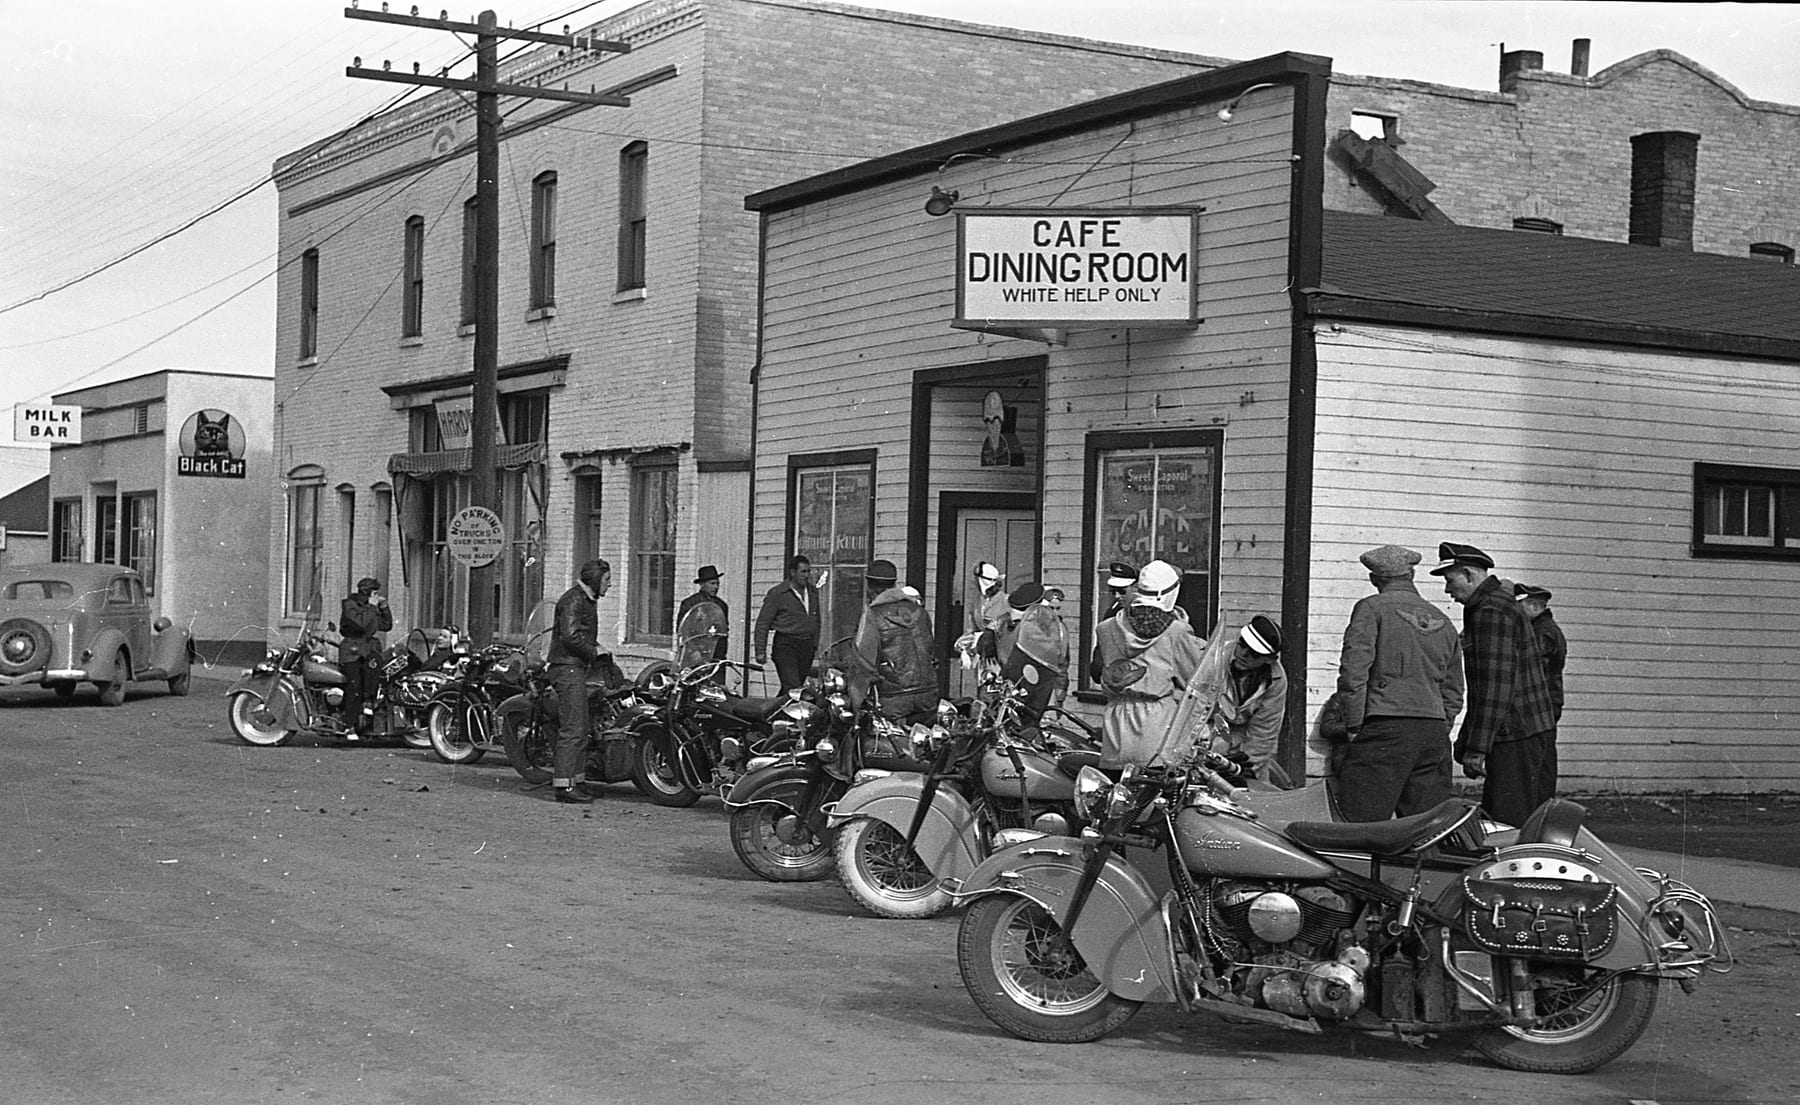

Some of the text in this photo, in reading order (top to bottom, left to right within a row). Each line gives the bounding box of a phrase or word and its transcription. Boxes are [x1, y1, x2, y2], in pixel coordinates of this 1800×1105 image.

[1033, 220, 1121, 247] CAFE
[968, 252, 1187, 284] DINING ROOM
[1003, 288, 1161, 302] WHITE HELP ONLY
[25, 409, 71, 422] MILK
[31, 425, 67, 438] BAR
[181, 457, 243, 475] Black Cat
[451, 509, 501, 535] NO PARKING
